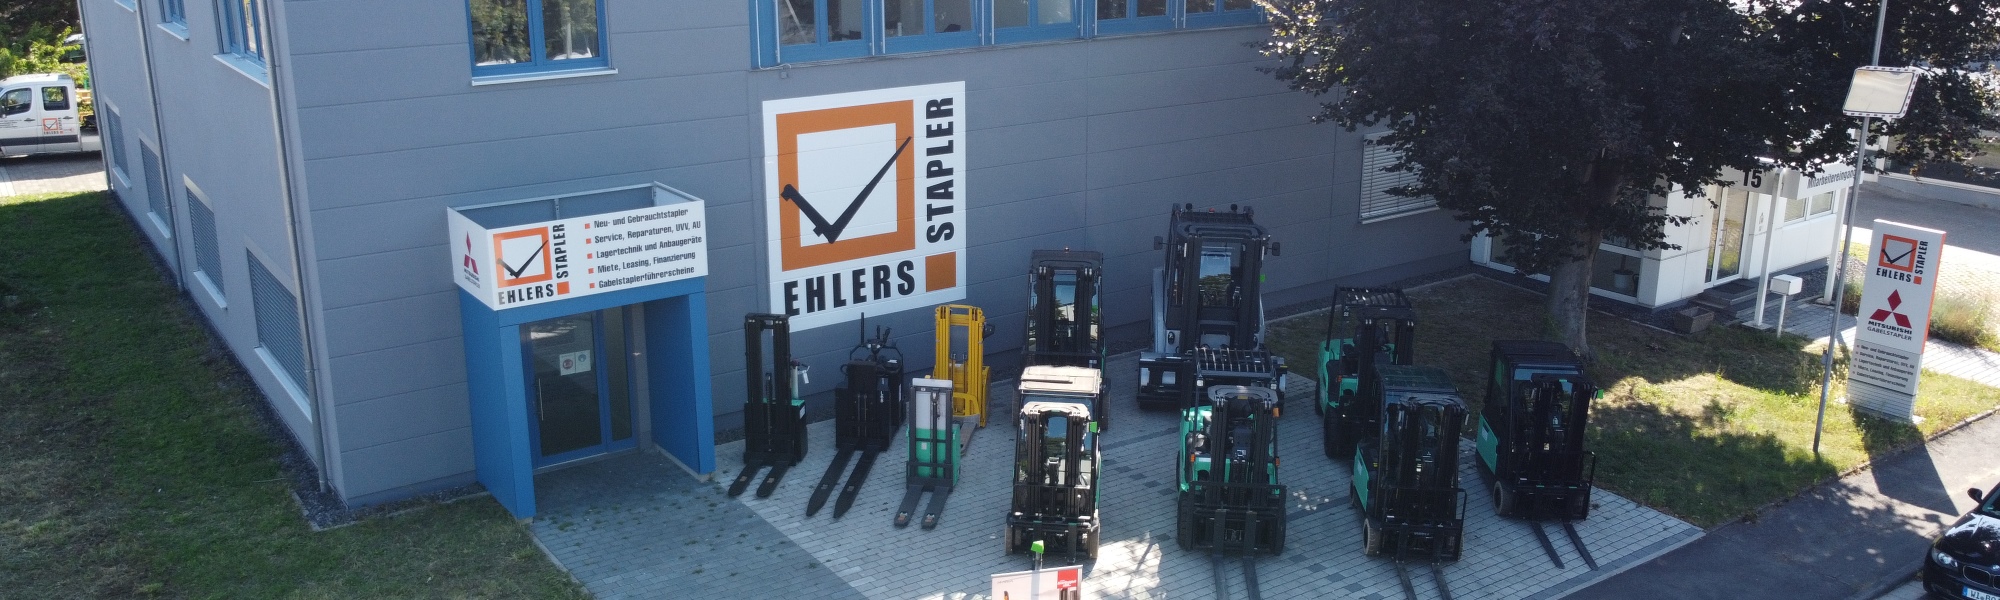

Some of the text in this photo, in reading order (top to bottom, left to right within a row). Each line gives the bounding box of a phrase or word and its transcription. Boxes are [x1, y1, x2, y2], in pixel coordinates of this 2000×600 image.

[926, 97, 954, 243] STAPLER
[1743, 170, 1762, 188] 15
[594, 208, 688, 229] Neu- und Gebrauchtstapler
[594, 221, 701, 244] Service, Reparaturen, UVV, AU
[552, 223, 569, 279] STAPLER
[596, 235, 702, 259] Lagertechnik und Anbaugeräte
[1914, 240, 1929, 275] STAPLER
[597, 251, 696, 274] Miete, Leasing, Finanzierung
[598, 266, 695, 289] Gabelstaplerführerscheine
[1876, 267, 1912, 283] EHLERS
[498, 283, 554, 305] EHLERS
[784, 260, 915, 316] EHLERS
[1867, 326, 1912, 341] GABELSTAPLER
[1868, 320, 1912, 335] MITSUBISHI
